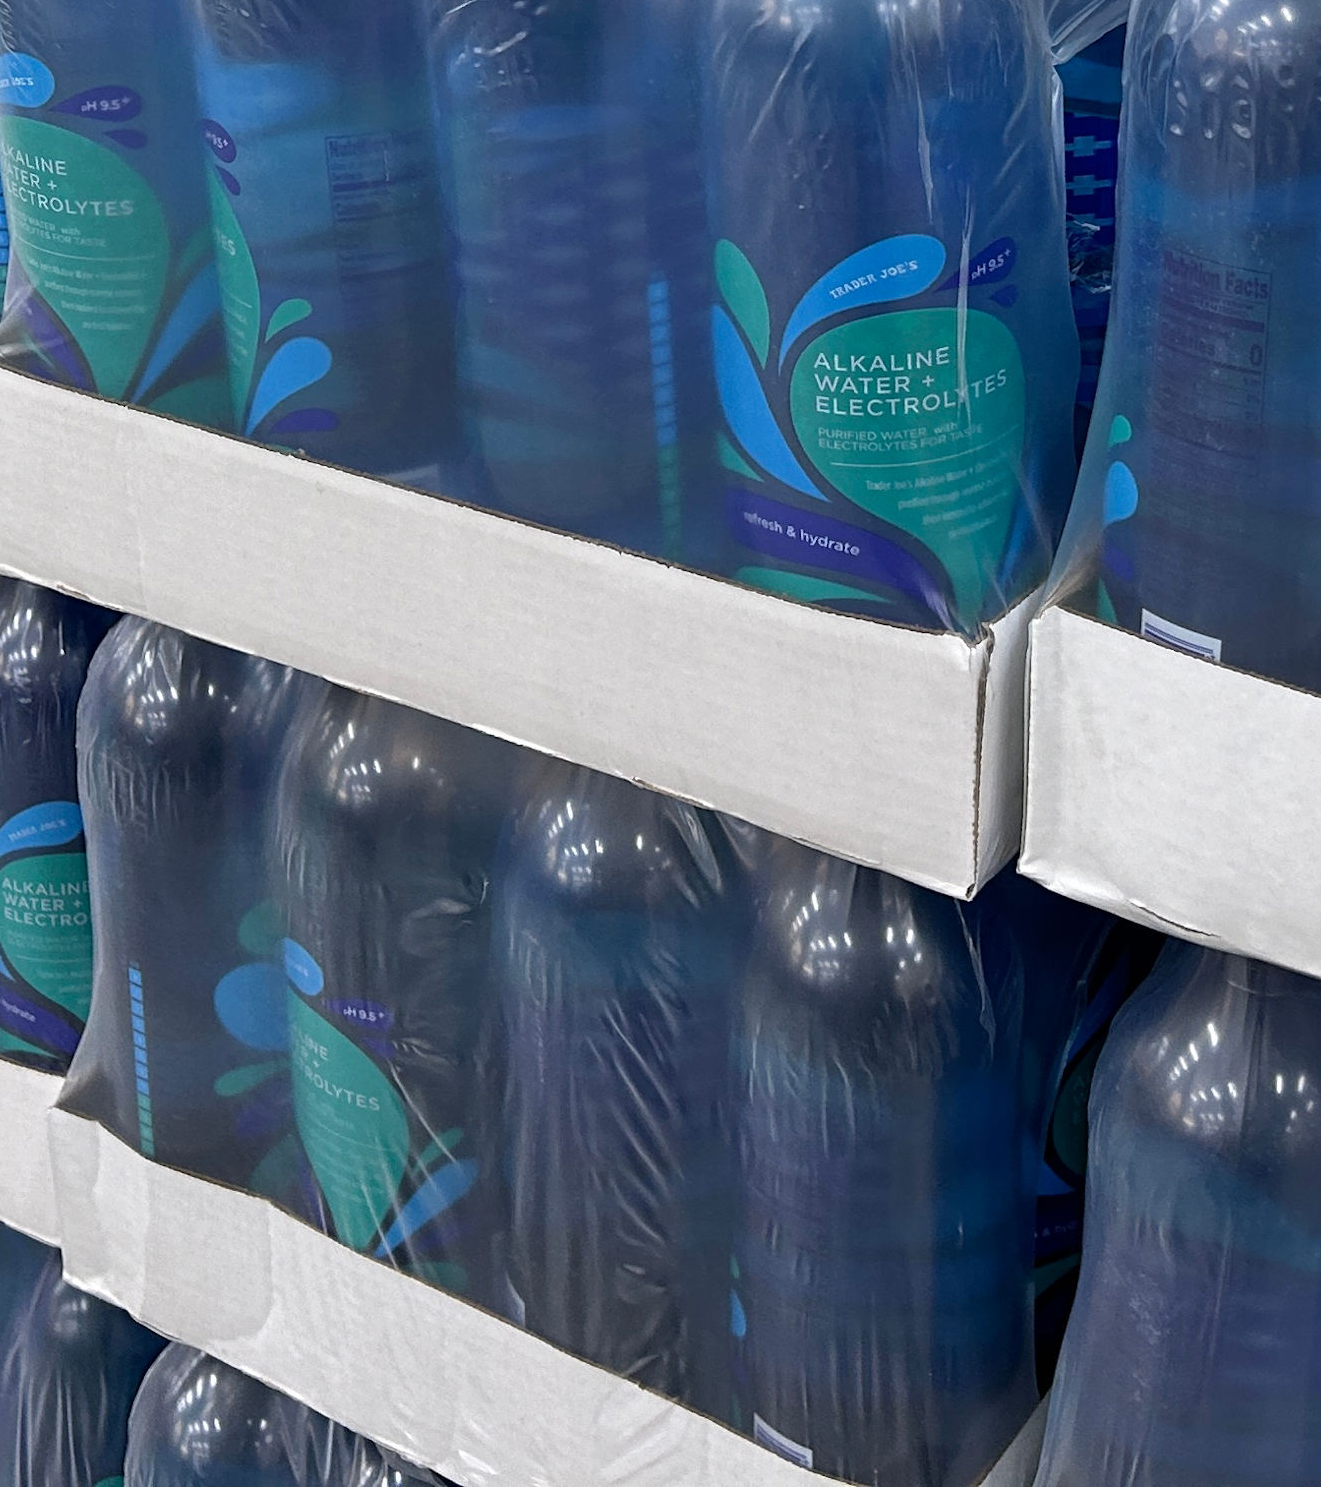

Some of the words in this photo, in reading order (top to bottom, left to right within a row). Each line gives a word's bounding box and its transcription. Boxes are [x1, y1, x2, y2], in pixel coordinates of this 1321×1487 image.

[4, 166, 41, 190] ATER
[5, 182, 134, 217] LECTROLYTES
[830, 274, 877, 300] TRADER
[880, 260, 919, 280] JOE'S
[1225, 270, 1269, 299] Facts
[814, 346, 951, 373] ALKALINE
[814, 373, 911, 395] WATER
[922, 375, 935, 388] +
[815, 369, 1008, 416] ELECTROLYTES
[818, 426, 877, 441] PURIFIED
[880, 427, 927, 441] WATER
[934, 422, 959, 435] with
[818, 438, 918, 452] ELECTROLYTES
[920, 434, 948, 448] FOR
[786, 524, 797, 539] &
[800, 528, 861, 557] hydrate
[3, 891, 64, 912] WATER
[4, 906, 88, 927] ELECTRO
